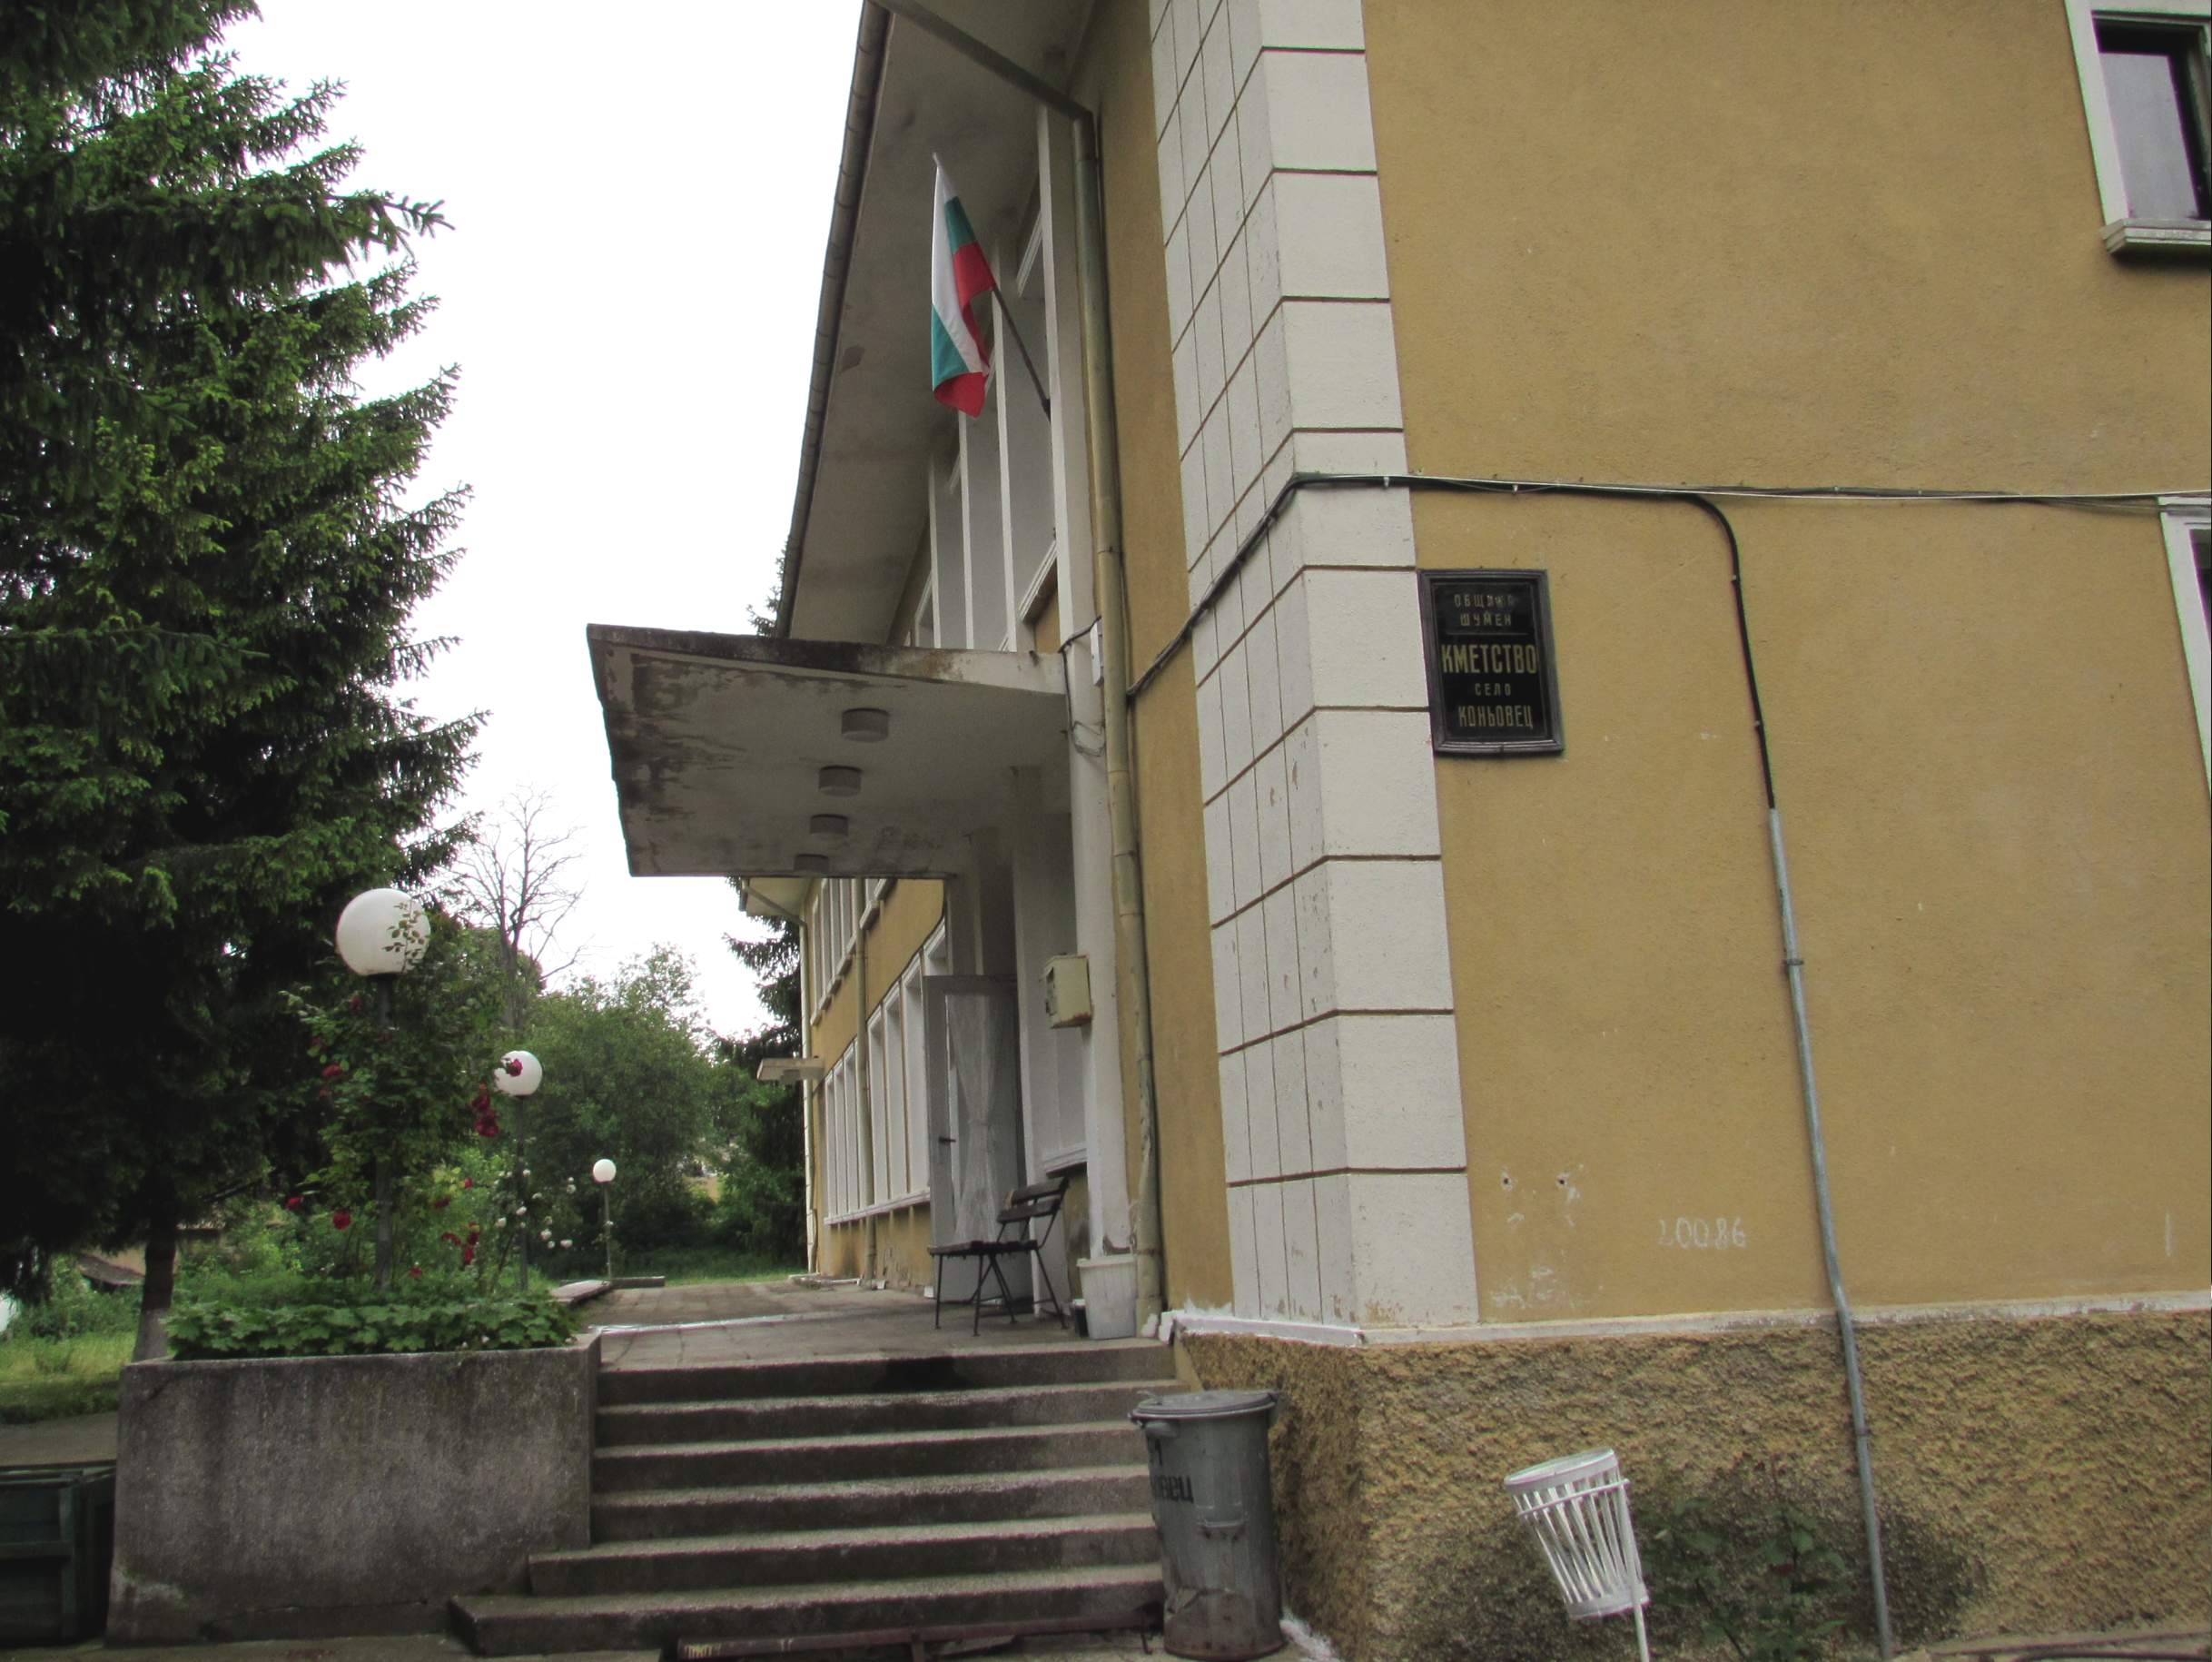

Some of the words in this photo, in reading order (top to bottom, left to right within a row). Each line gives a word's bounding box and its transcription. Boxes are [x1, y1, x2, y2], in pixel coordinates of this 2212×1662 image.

[1460, 611, 1512, 627] ШУМЕН
[1441, 644, 1538, 674] КМЕТСТВО
[1475, 683, 1512, 697] СЕЛО
[1458, 705, 1534, 729] КОНЬОВЕЦ
